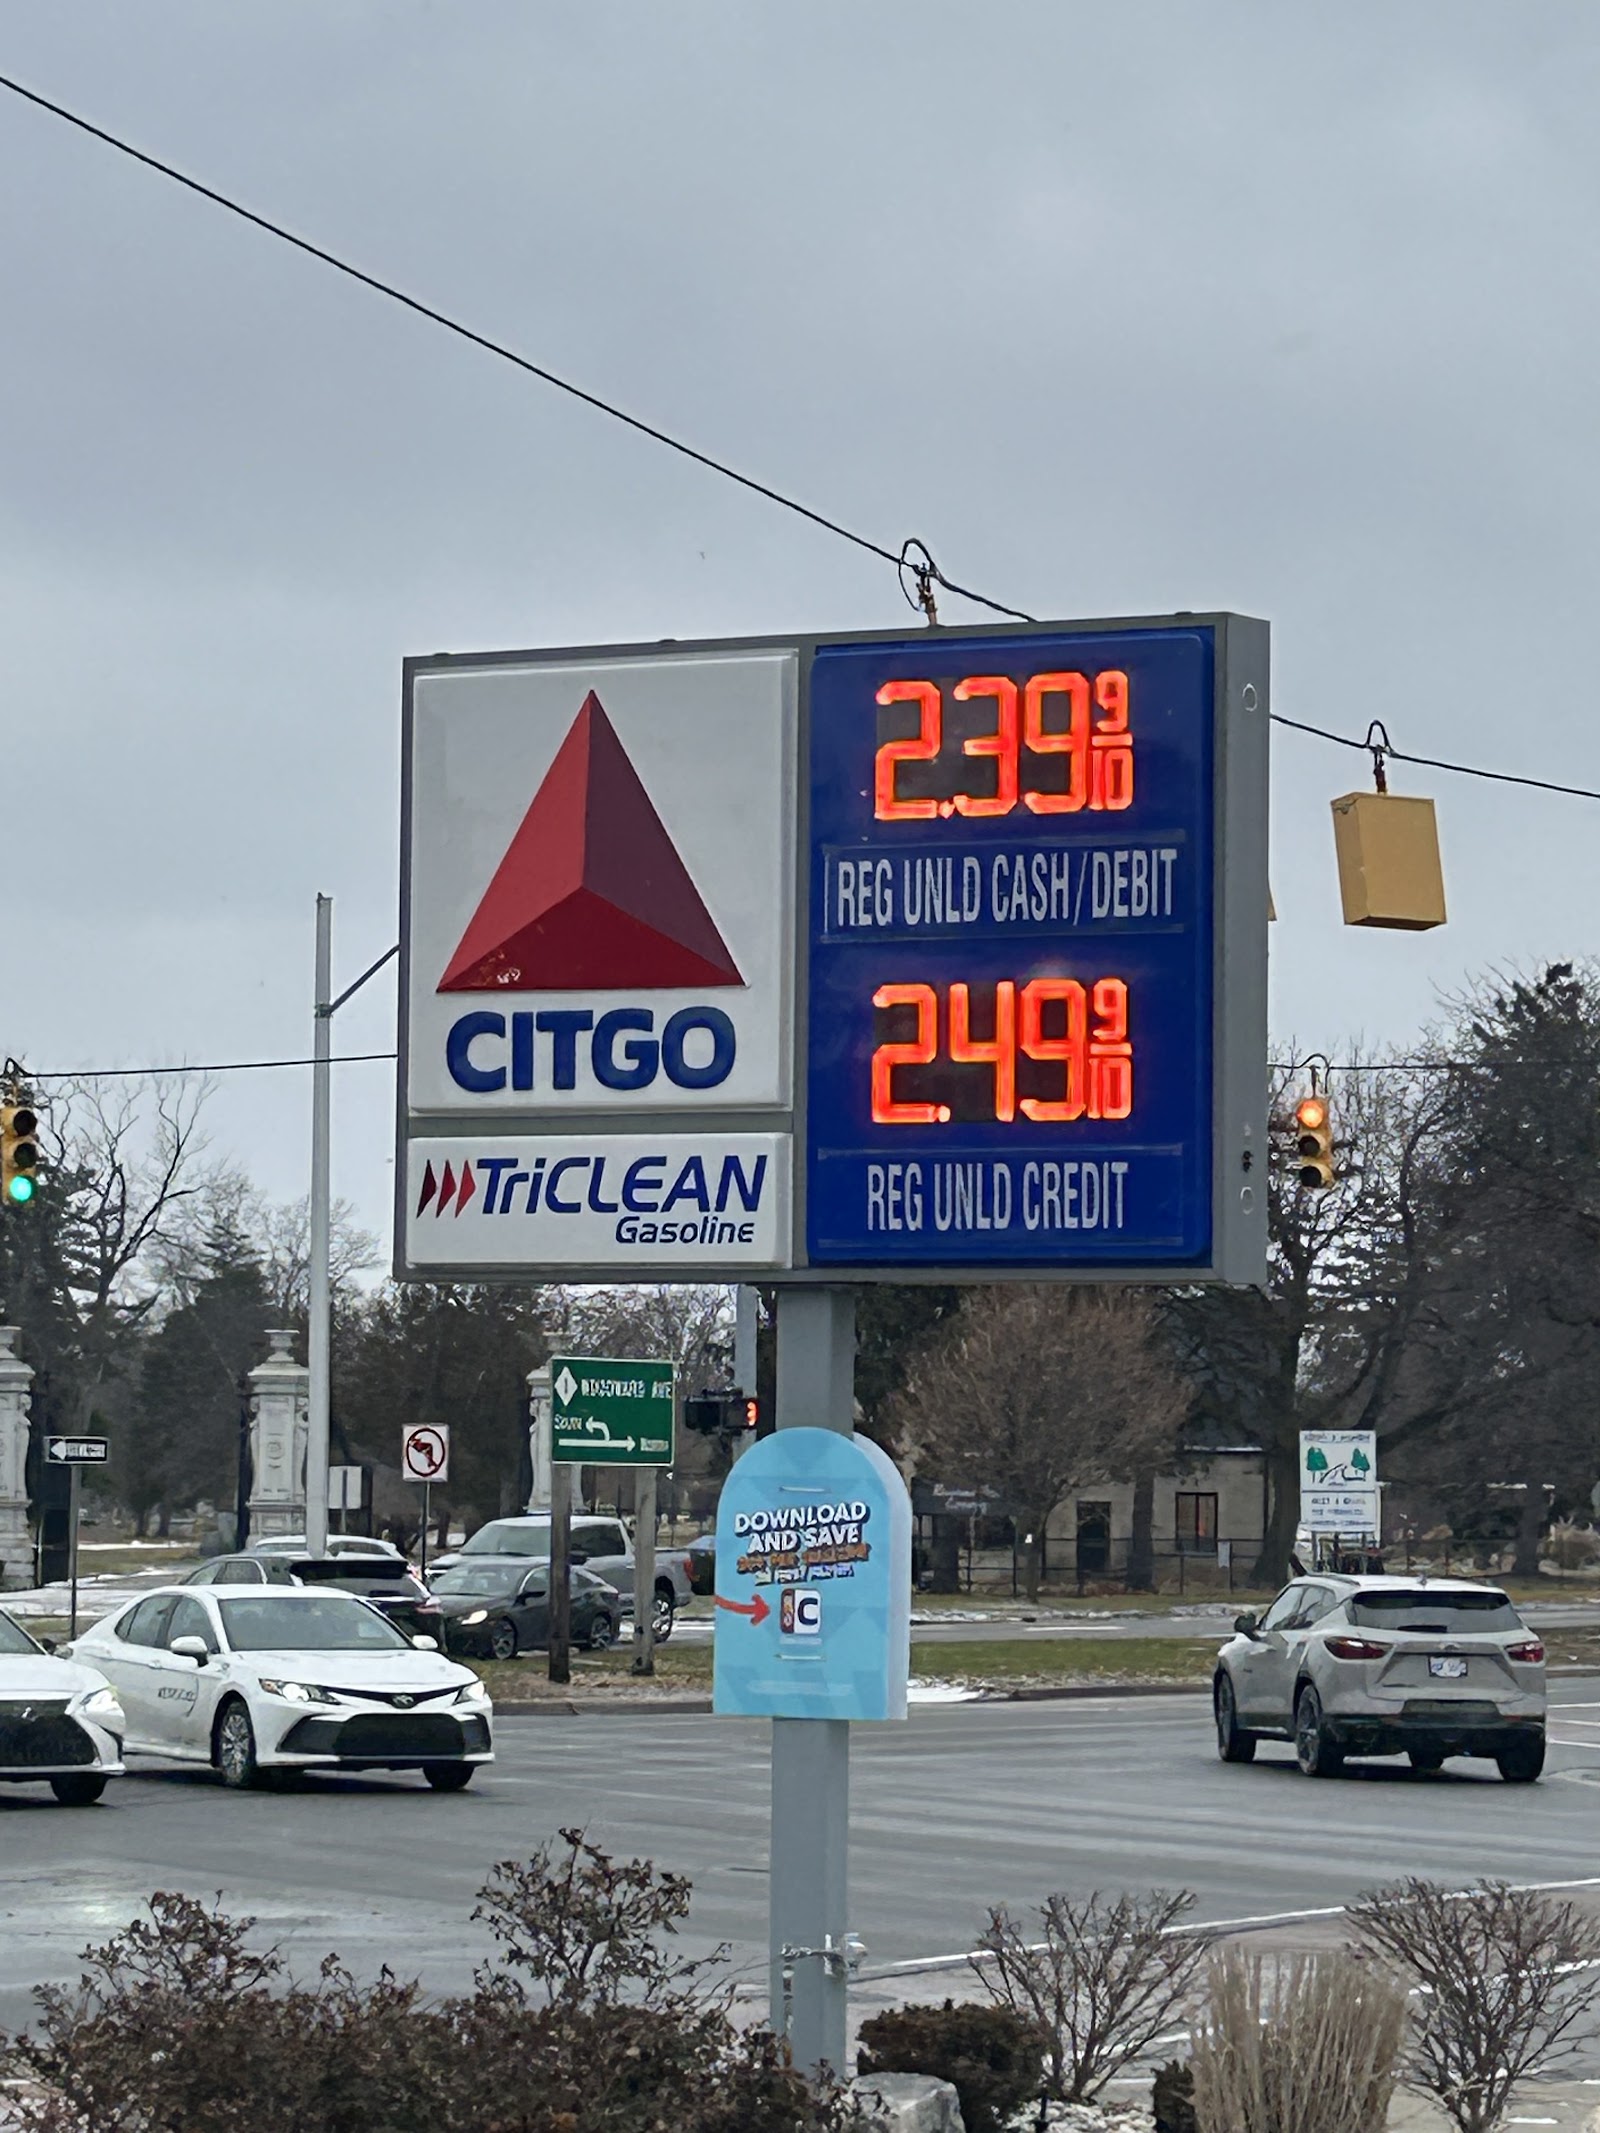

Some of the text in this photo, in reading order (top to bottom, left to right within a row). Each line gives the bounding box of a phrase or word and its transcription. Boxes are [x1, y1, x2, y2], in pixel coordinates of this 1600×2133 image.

[874, 672, 1089, 820] 2.39
[838, 849, 1177, 927] REG UNLD CASH/DEBIT
[446, 1006, 736, 1093] CITGO
[872, 979, 1086, 1123] 2.49
[477, 1154, 768, 1214] TriCLEAN
[867, 1161, 1129, 1231] REG UNLD CREDIT
[615, 1216, 755, 1244] Gasoline
[735, 1501, 868, 1534] DOWNLOAD
[747, 1523, 860, 1554] AND SAVE
[797, 1597, 818, 1625] C
